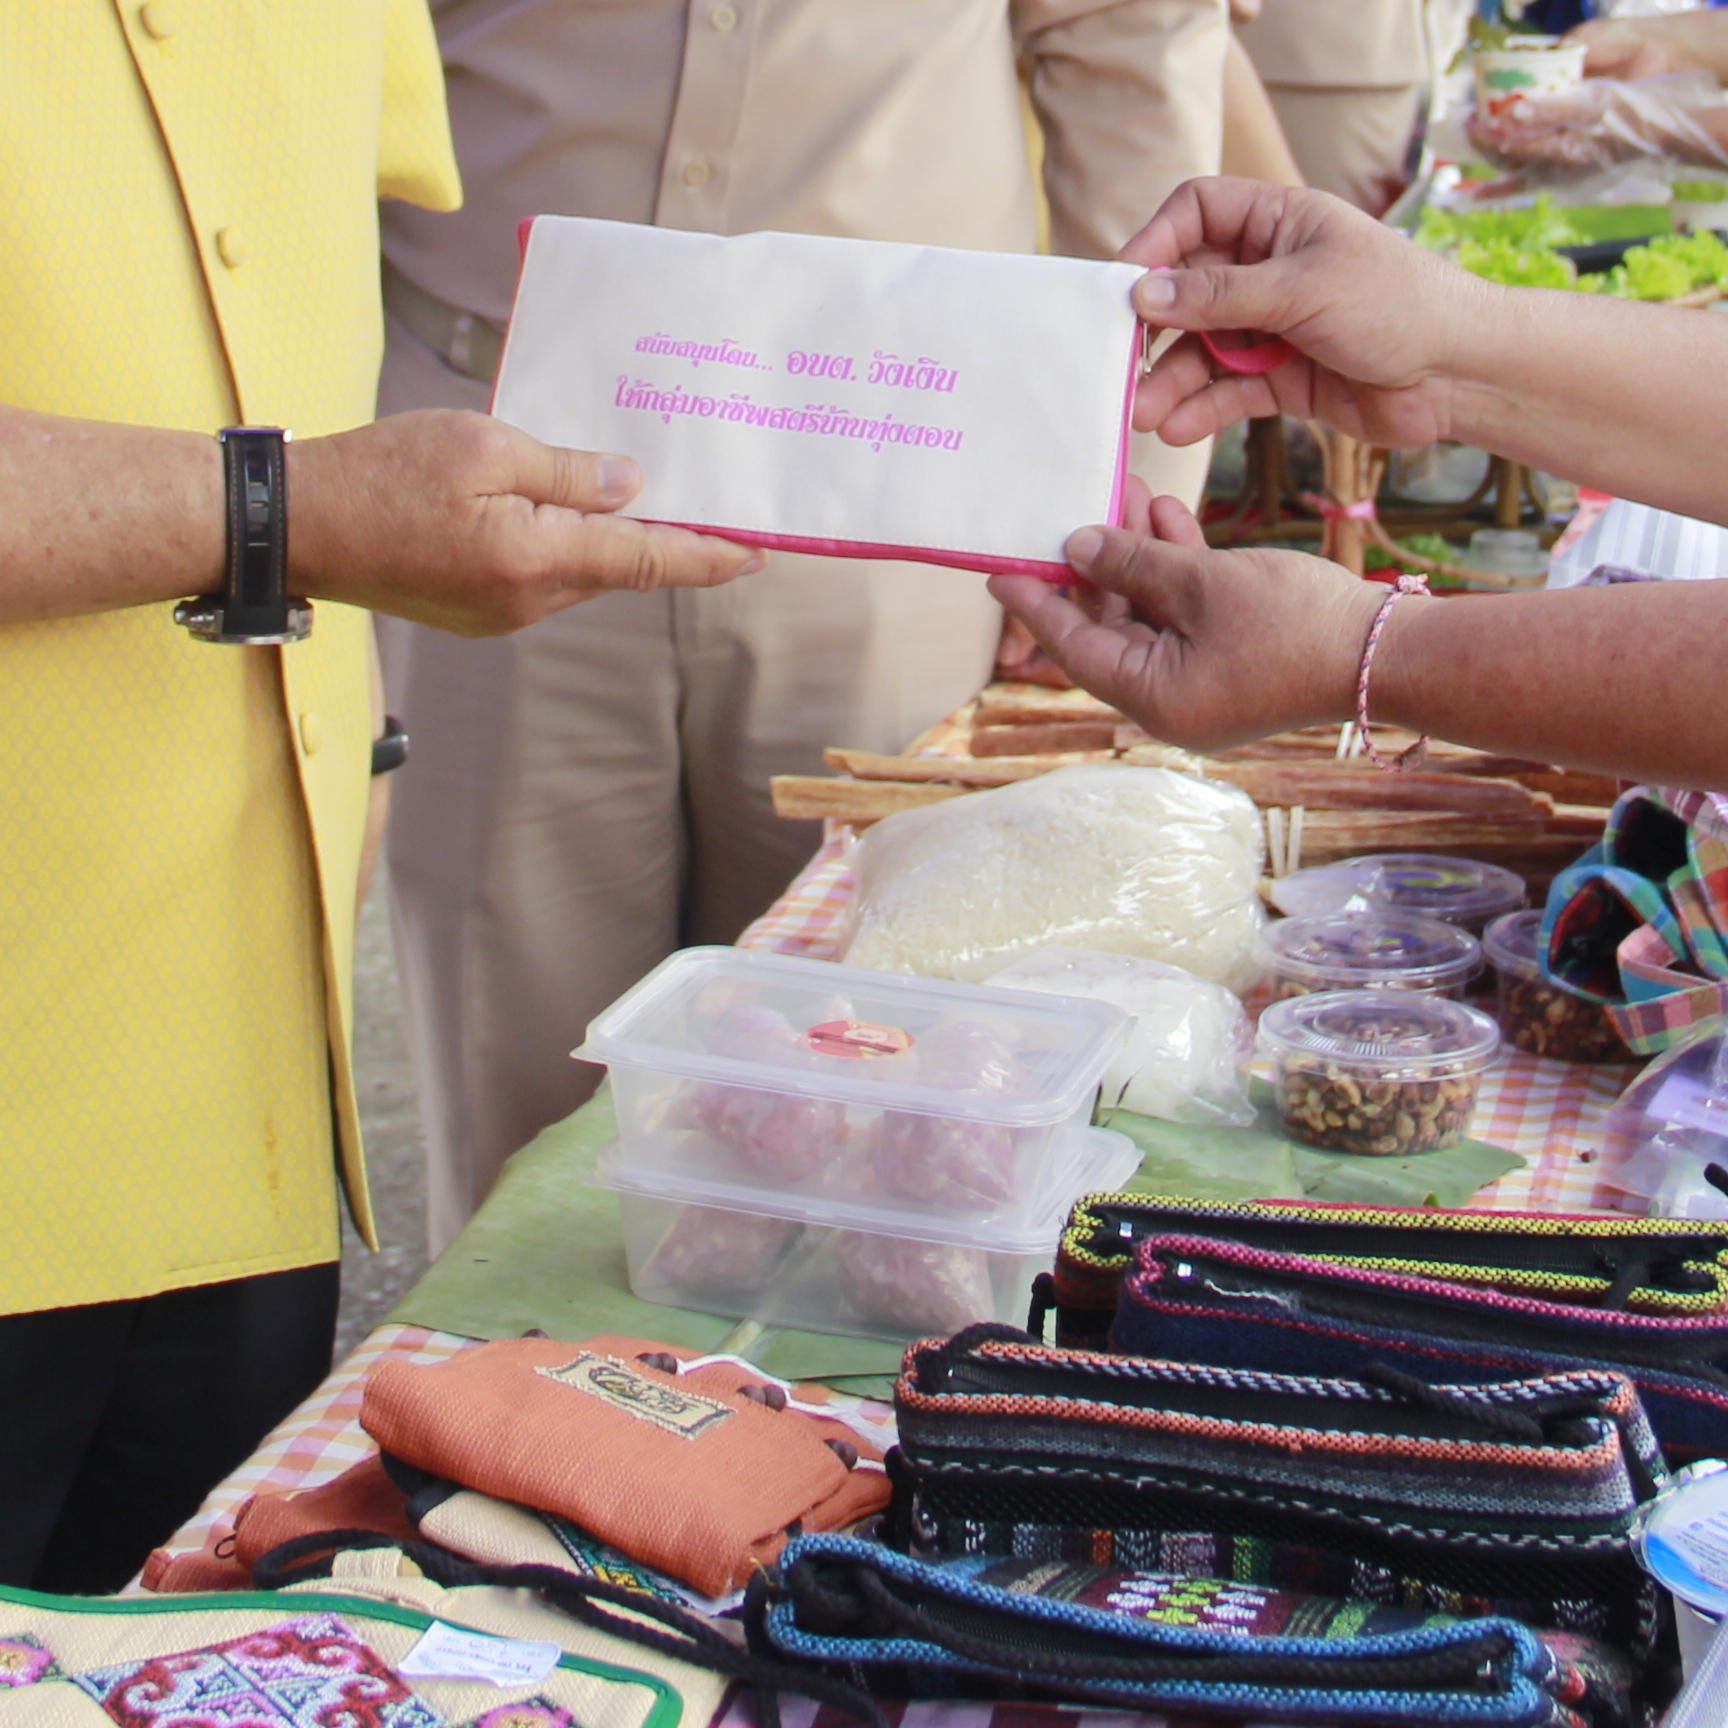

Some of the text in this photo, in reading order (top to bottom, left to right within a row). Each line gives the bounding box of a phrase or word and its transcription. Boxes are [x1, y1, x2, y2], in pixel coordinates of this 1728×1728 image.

[786, 350, 857, 381] อบต.
[867, 349, 960, 393] วังเงิน
